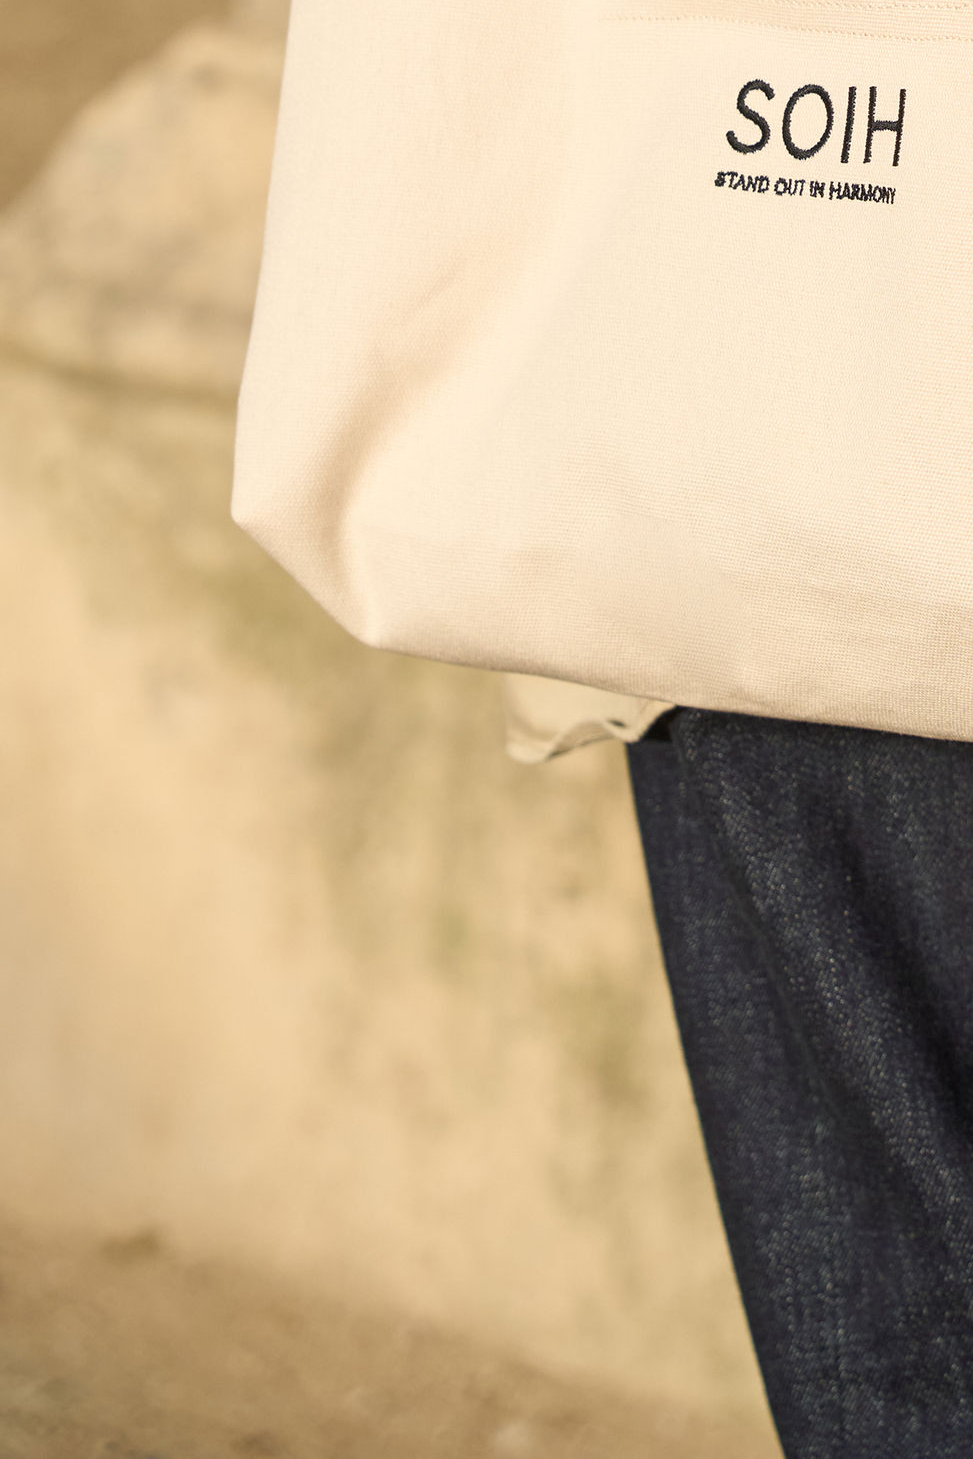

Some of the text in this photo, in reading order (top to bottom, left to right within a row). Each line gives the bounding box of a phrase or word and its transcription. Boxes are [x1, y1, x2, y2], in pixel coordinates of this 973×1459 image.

[726, 79, 906, 166] SOIH
[714, 170, 896, 204] STAND OUT IN HARMONY
